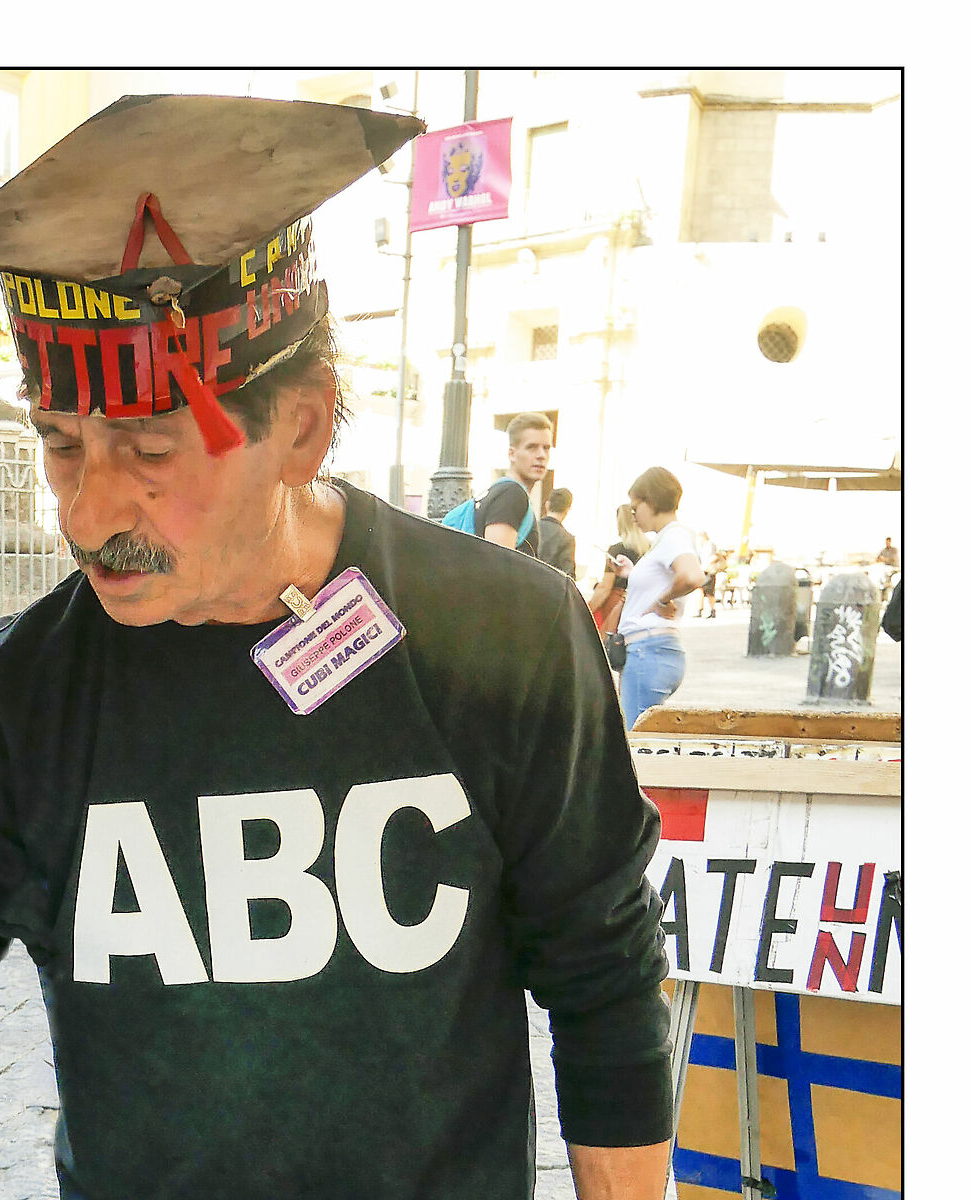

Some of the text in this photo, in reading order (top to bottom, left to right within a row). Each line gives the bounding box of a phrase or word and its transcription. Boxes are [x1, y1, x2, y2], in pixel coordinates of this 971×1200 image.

[3, 273, 141, 321] POLONE
[13, 303, 247, 419] TTORE
[274, 593, 364, 669] CAMPIONE DEL MONDO
[290, 615, 364, 678] GIUSEPPE POLONE
[297, 622, 383, 696] CUBI MAGICI
[72, 772, 472, 987] ABC
